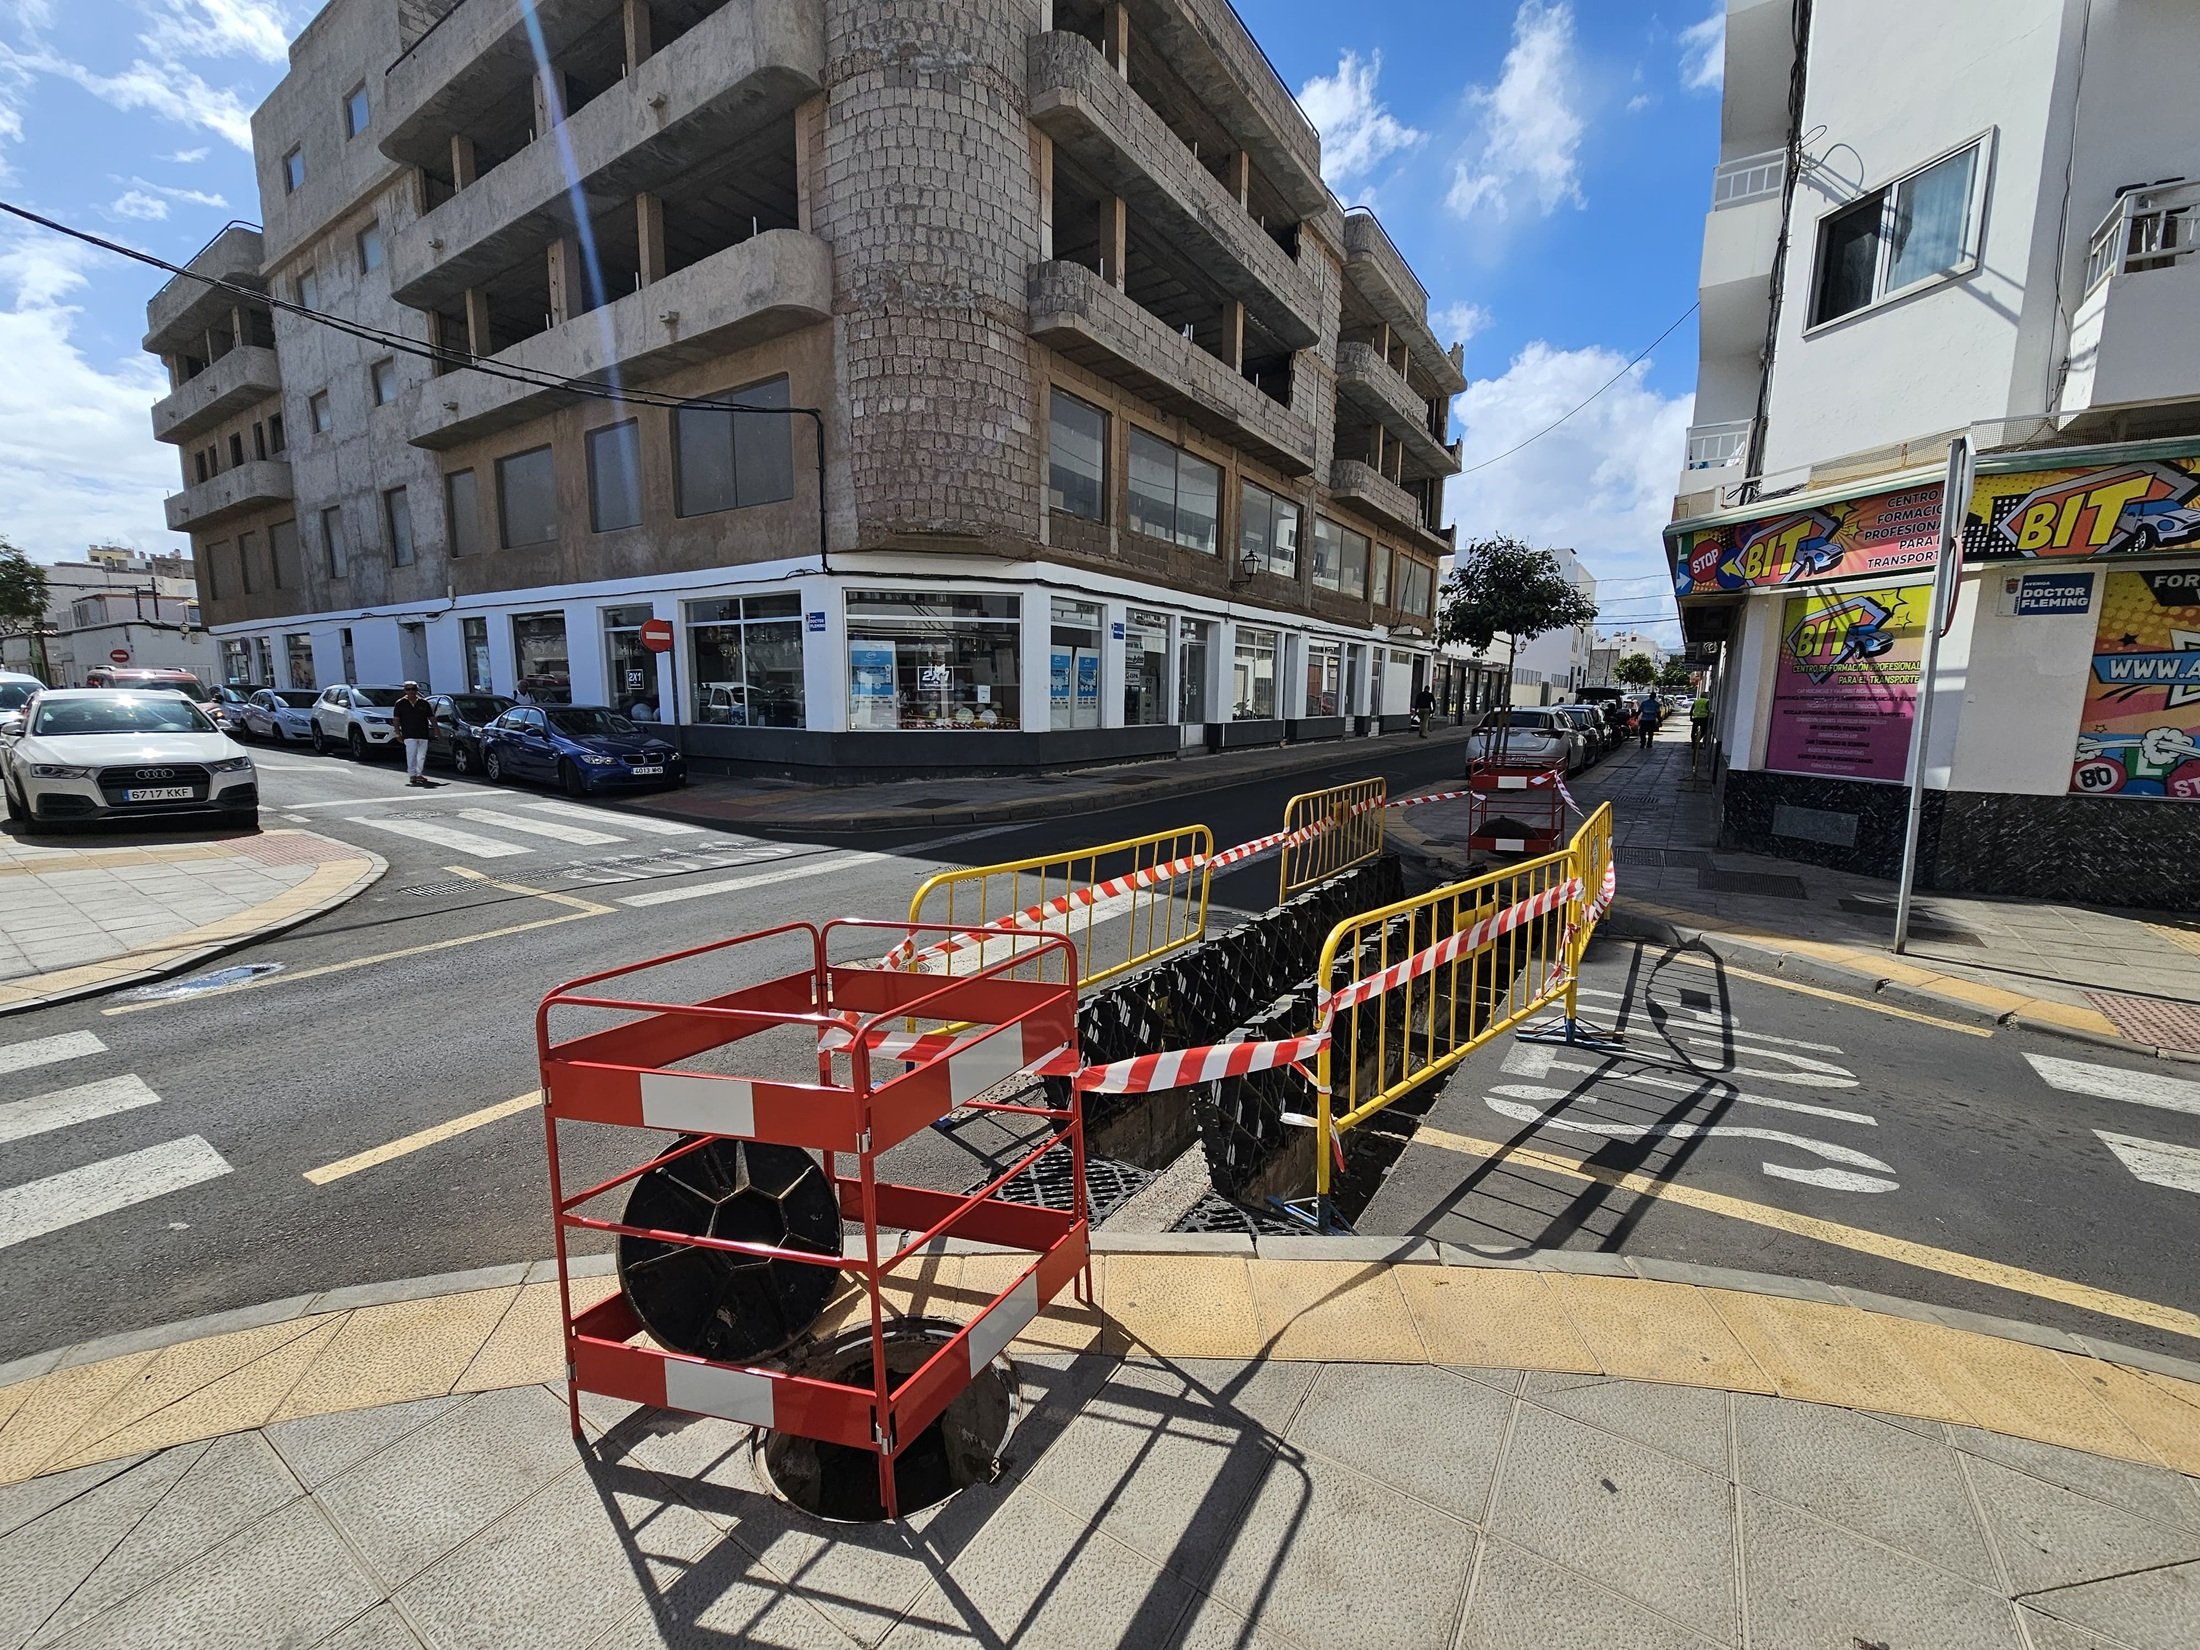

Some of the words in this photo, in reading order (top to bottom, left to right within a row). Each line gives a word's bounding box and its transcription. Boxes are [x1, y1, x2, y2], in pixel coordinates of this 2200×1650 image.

[1888, 490, 1938, 508] CENTRO
[2016, 473, 2155, 551] BIT
[1744, 518, 1814, 580] BIT
[1899, 536, 1933, 550] PARA
[1692, 548, 1719, 574] STOP
[2022, 587, 2086, 598] DOCTOR
[2020, 597, 2089, 608] FLEMING
[1796, 606, 1865, 658] BIT
[1792, 664, 1818, 673] CENTRO
[1819, 664, 1828, 672] DE
[1829, 662, 1869, 673] FORMACIÓN
[1870, 661, 1920, 672] PROFESIONAL
[628, 672, 642, 682] 2X1
[1838, 675, 1857, 684] PARA
[1859, 675, 1867, 684] EL
[1870, 674, 1920, 684] TRANSPORTE
[2079, 765, 2112, 788] 80
[132, 789, 163, 799] 6717
[166, 788, 189, 798] KKF
[1483, 986, 1901, 1194] STOP
